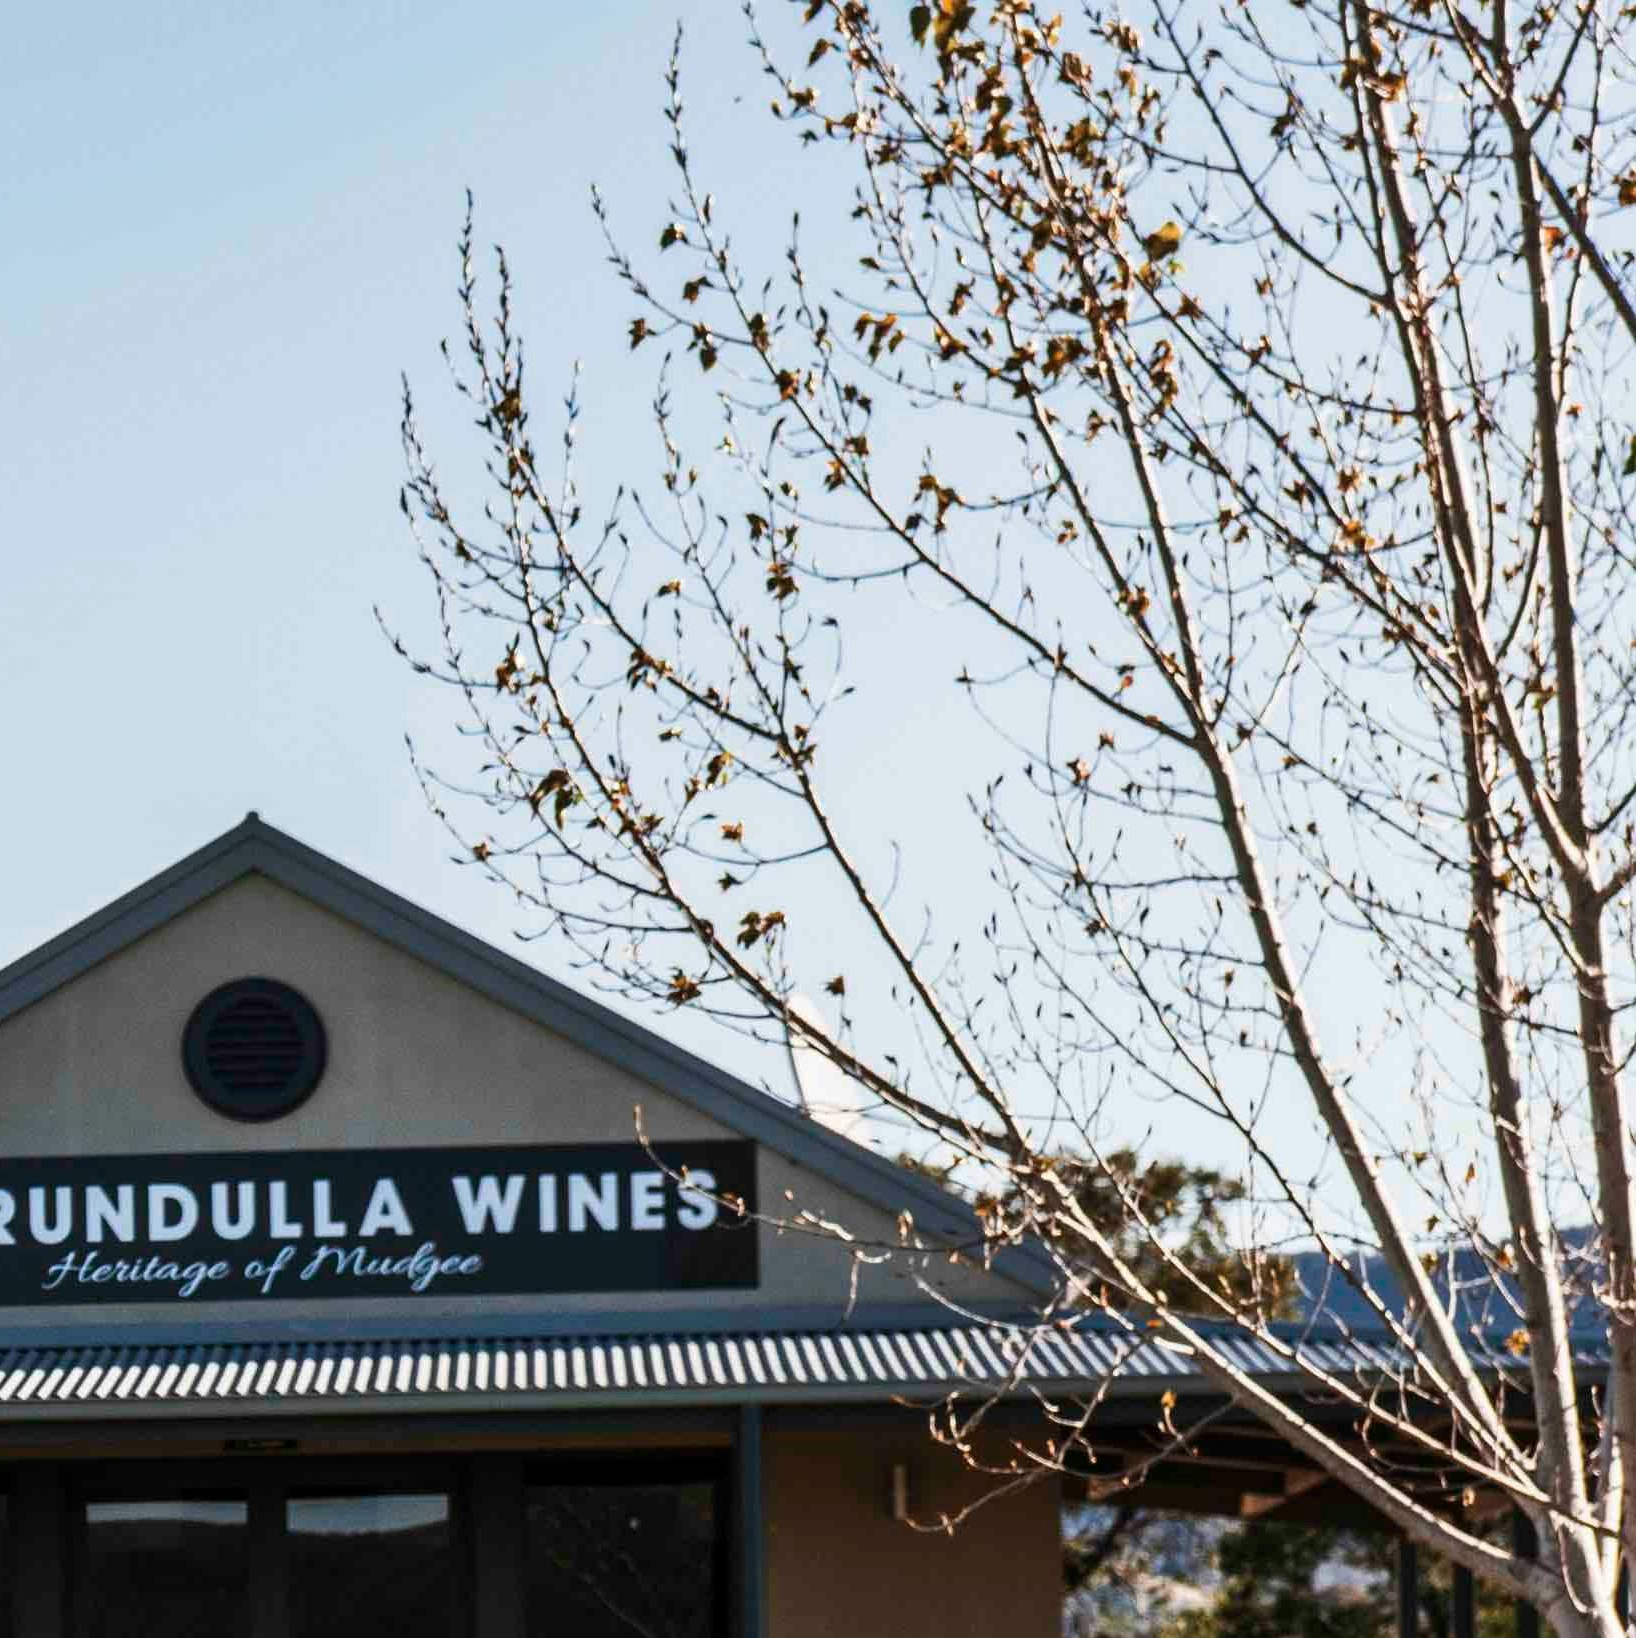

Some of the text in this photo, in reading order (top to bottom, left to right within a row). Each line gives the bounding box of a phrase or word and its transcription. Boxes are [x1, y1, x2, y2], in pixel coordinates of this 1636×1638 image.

[451, 1166, 719, 1235] WINES
[41, 1241, 481, 1298] Heritage of Mudgee
